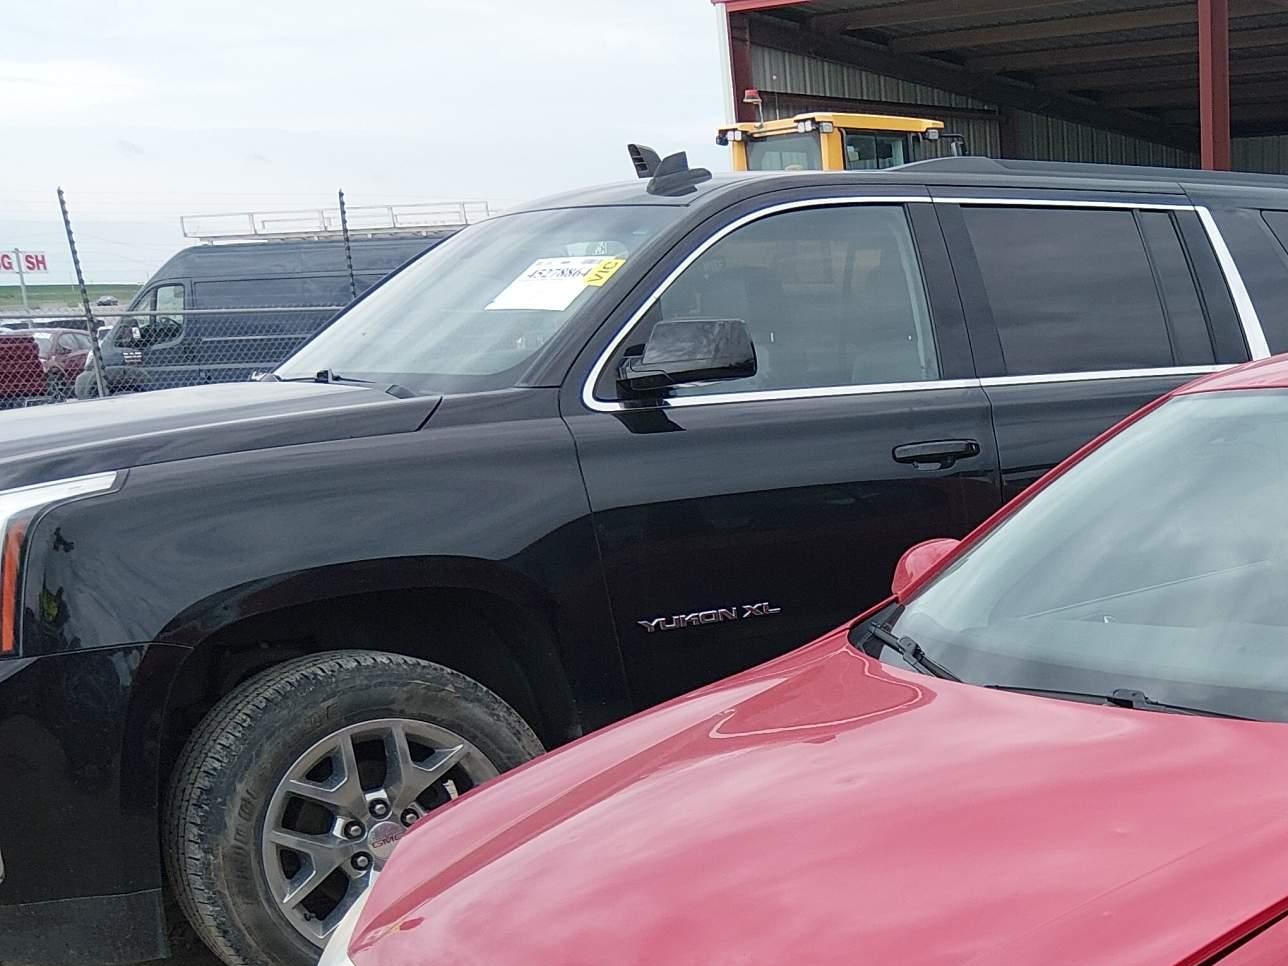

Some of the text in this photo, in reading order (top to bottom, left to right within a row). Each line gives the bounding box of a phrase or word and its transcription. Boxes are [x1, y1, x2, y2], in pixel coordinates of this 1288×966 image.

[0, 254, 47, 270] G SH
[587, 261, 619, 283] VIC
[636, 602, 781, 633] YUKON XL
[371, 832, 404, 849] GMC
